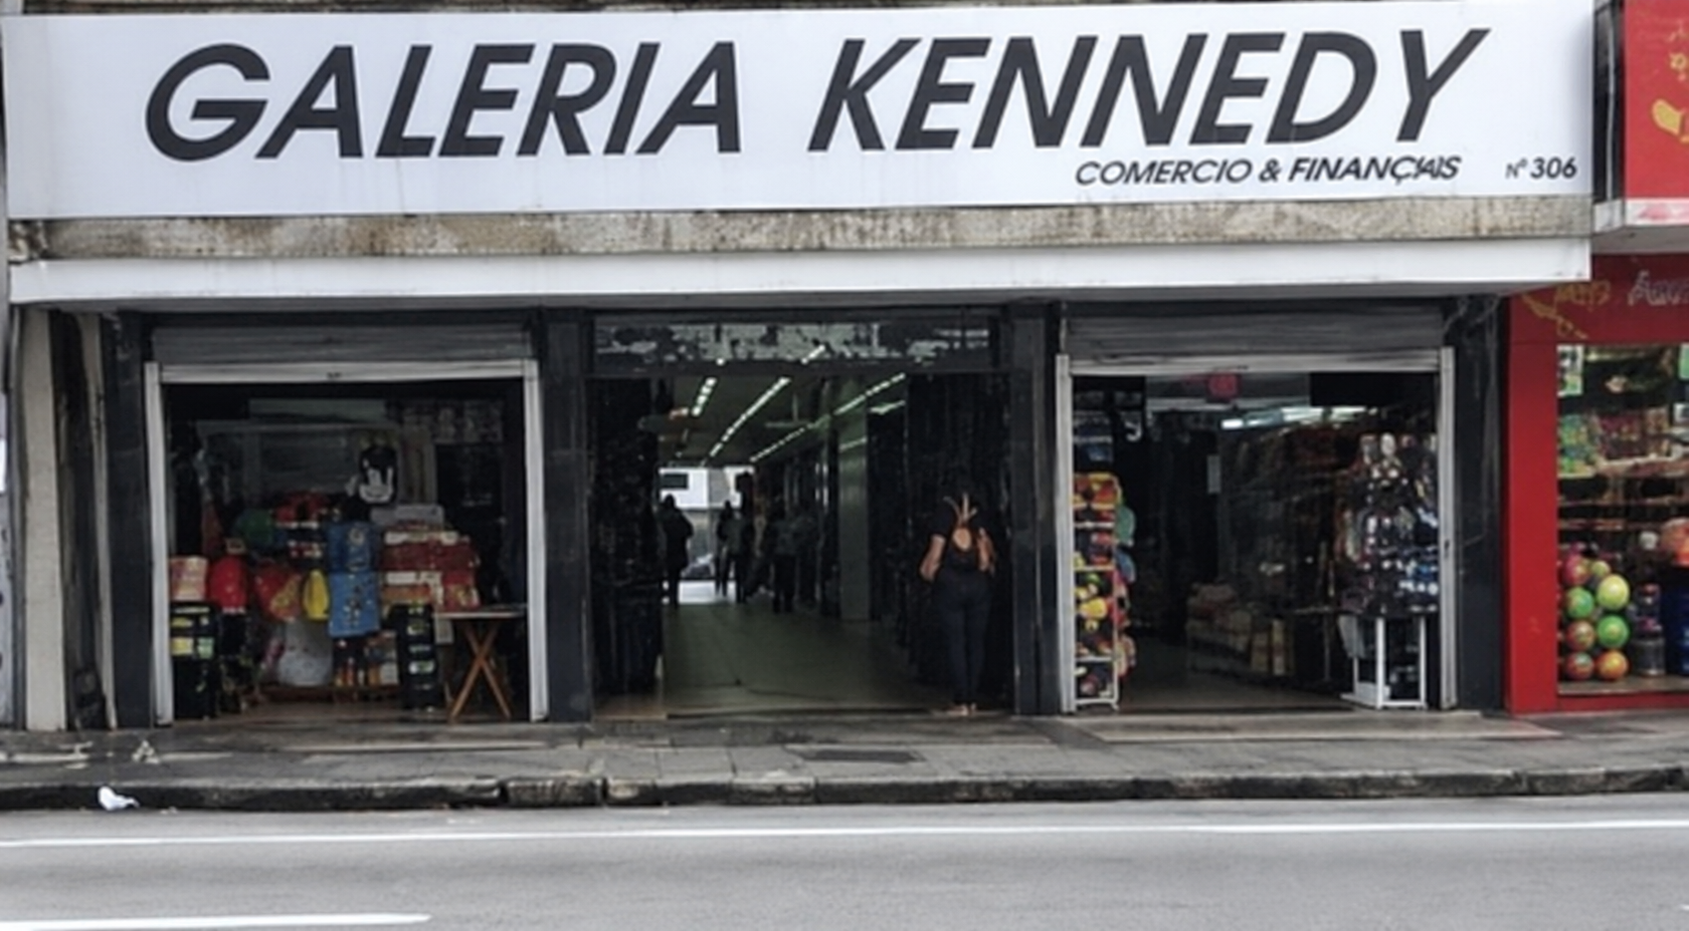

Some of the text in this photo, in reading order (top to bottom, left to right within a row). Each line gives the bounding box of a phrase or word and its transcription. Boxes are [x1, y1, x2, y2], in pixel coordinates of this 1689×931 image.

[145, 28, 1490, 162] GALERIA KENNEDY
[1075, 159, 1253, 185] COMERCIO
[1258, 159, 1281, 182] &
[1530, 157, 1578, 179] 306
